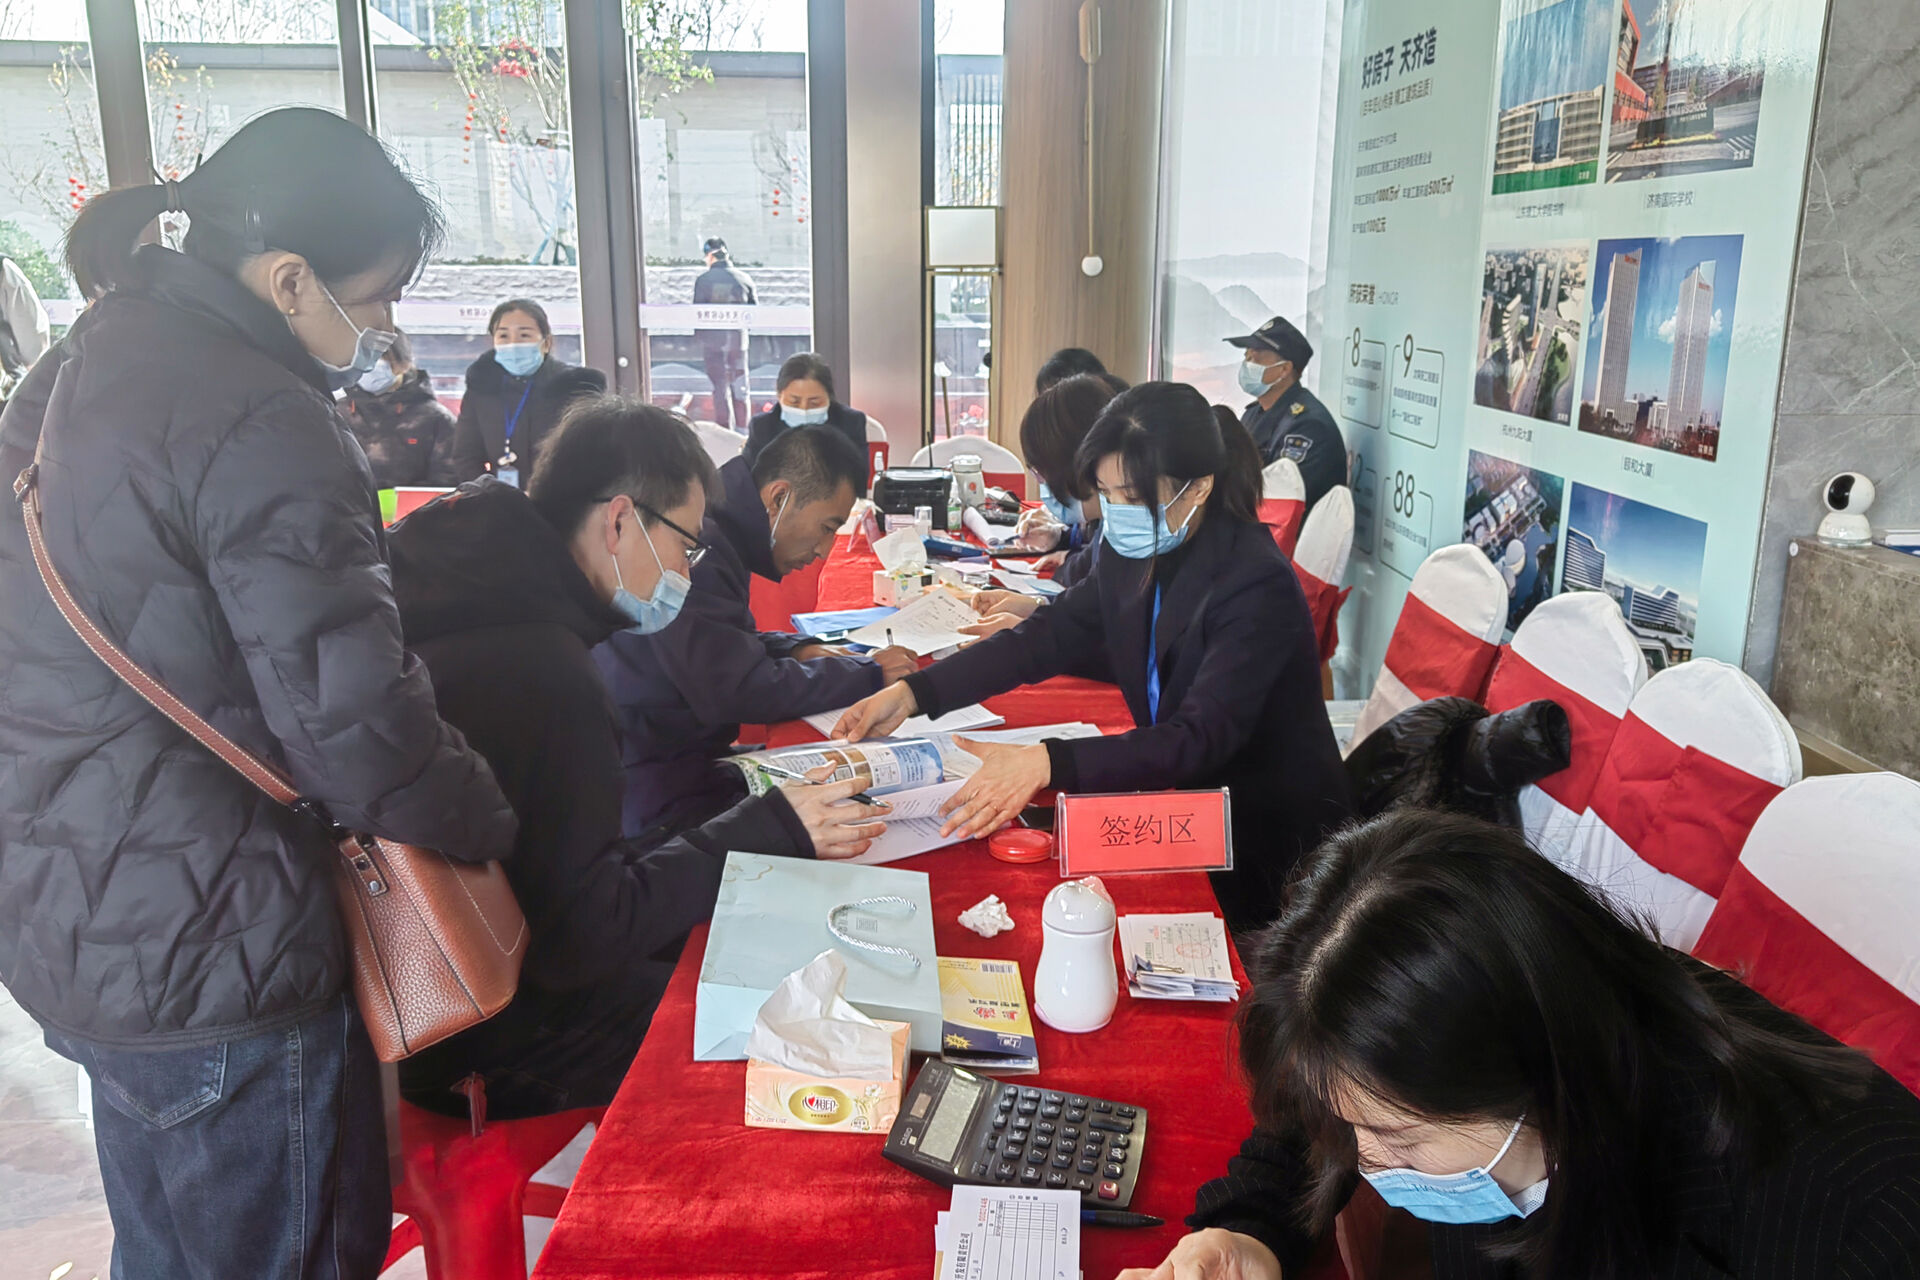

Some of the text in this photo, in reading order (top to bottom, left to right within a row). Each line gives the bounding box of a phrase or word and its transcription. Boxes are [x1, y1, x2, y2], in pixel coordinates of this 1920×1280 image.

[1361, 26, 1437, 90] 好房子 天齐造
[1351, 327, 1361, 367] 8
[1403, 334, 1414, 378] 9
[1394, 470, 1415, 518] 88
[1100, 813, 1196, 847] 签约区
[900, 1127, 913, 1146] CASIO
